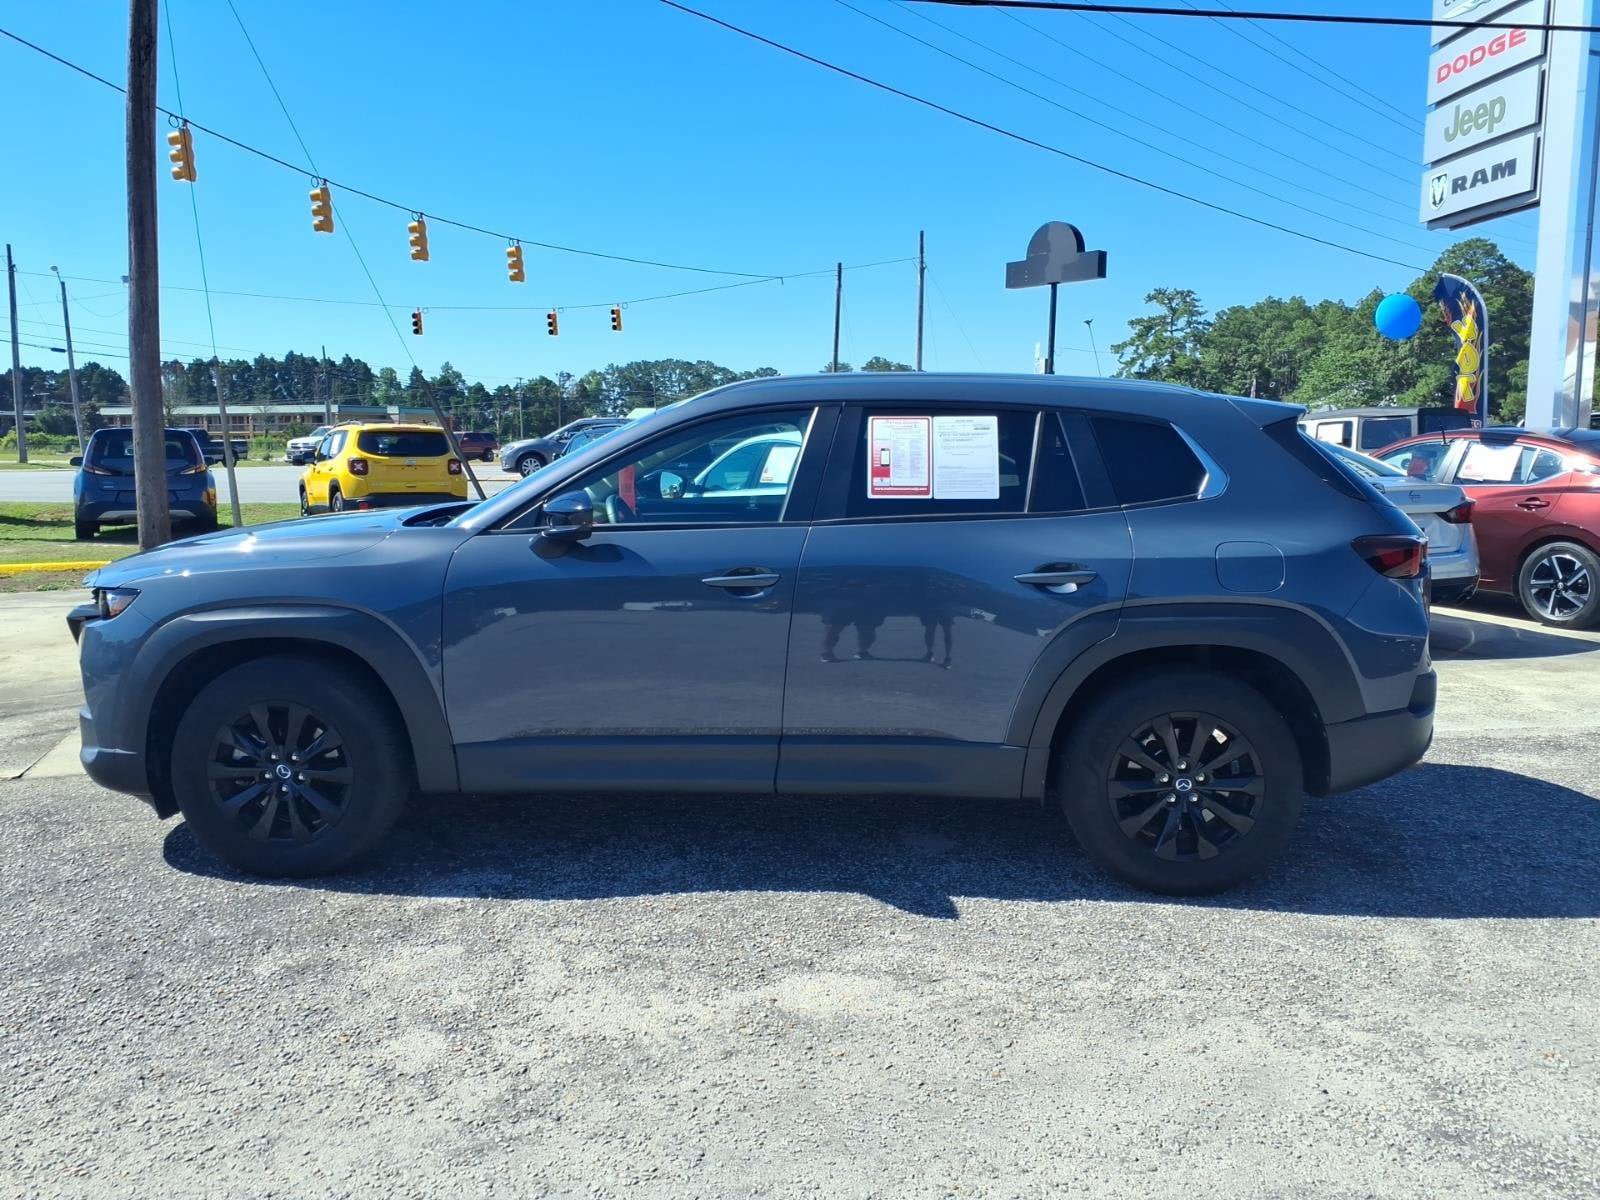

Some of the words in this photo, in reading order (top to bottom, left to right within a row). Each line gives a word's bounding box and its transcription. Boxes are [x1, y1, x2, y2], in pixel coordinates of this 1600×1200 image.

[1436, 27, 1526, 84] DODGE
[1444, 96, 1507, 142] Jeep
[1451, 158, 1517, 195] RAM
